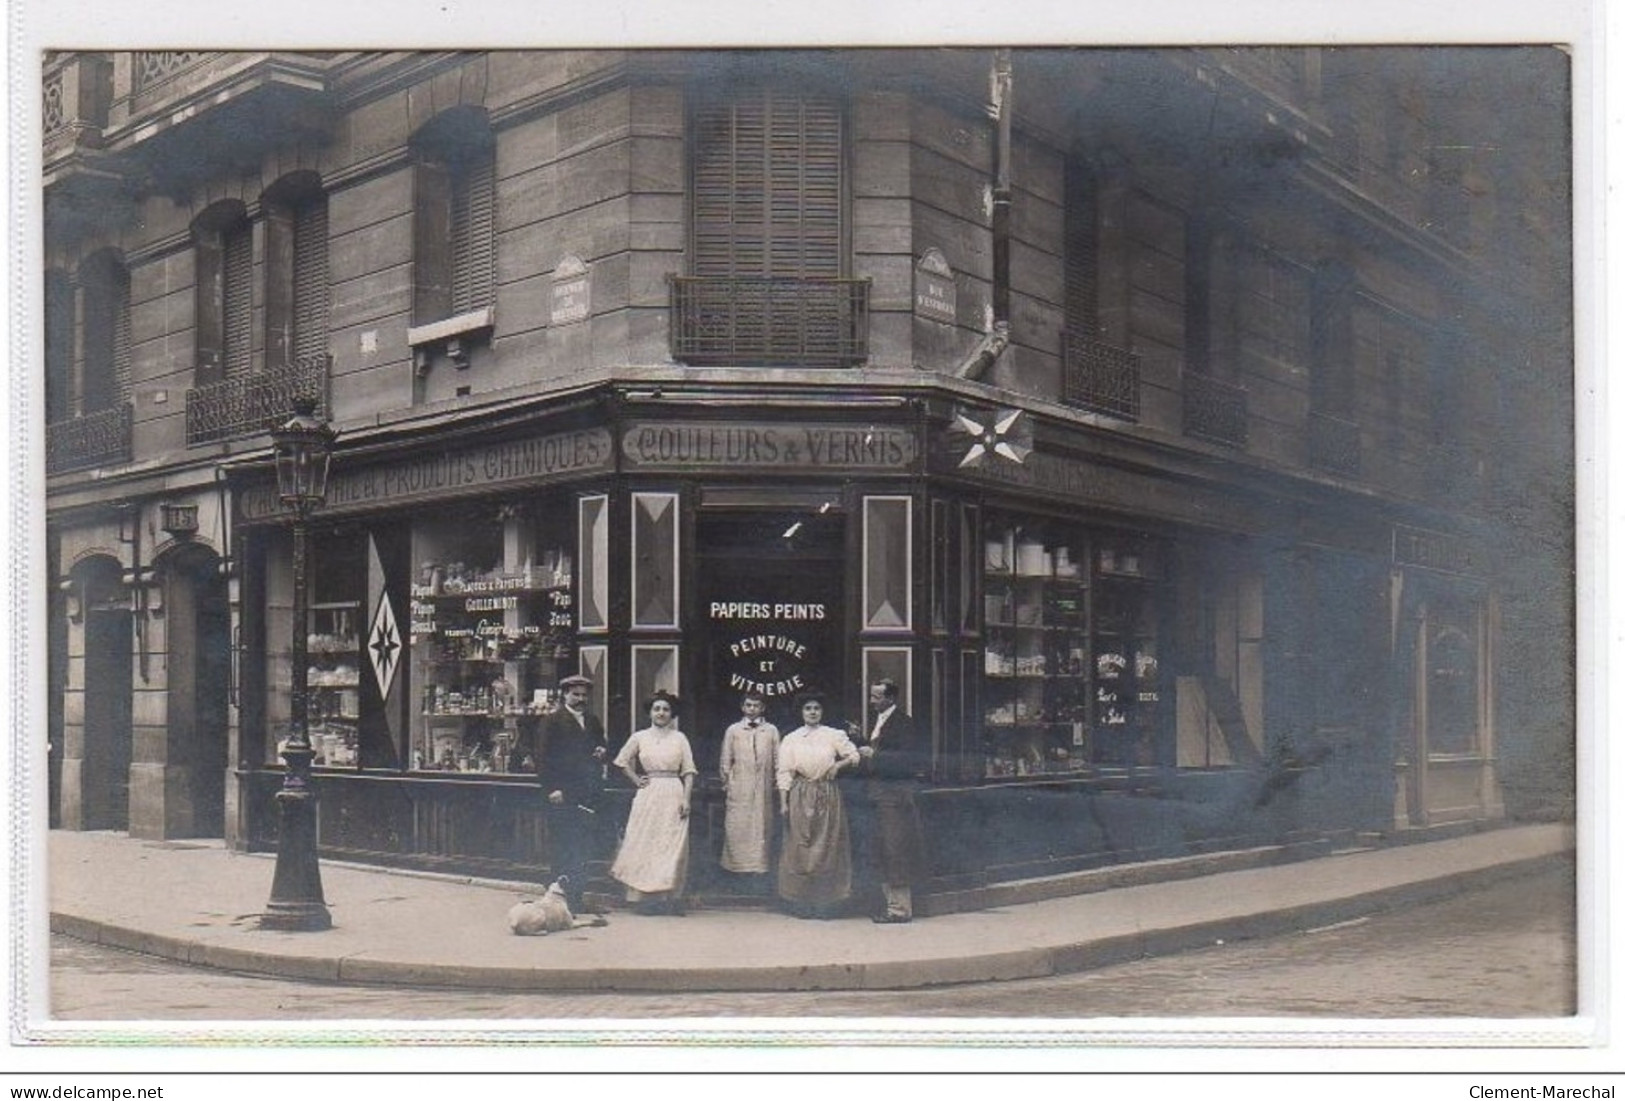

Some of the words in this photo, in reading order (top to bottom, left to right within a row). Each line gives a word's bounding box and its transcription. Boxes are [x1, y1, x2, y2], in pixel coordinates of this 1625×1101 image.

[636, 427, 778, 462] COULEURS
[803, 428, 904, 464] VERNIS
[381, 453, 477, 497] PRODUITS
[482, 430, 601, 480] CHIMIQUES
[710, 601, 771, 619] PAPIERS
[774, 603, 826, 620] PEINTS
[730, 634, 807, 660] PEINTURE
[759, 660, 775, 673] ET
[730, 672, 805, 697] VITRERIE
